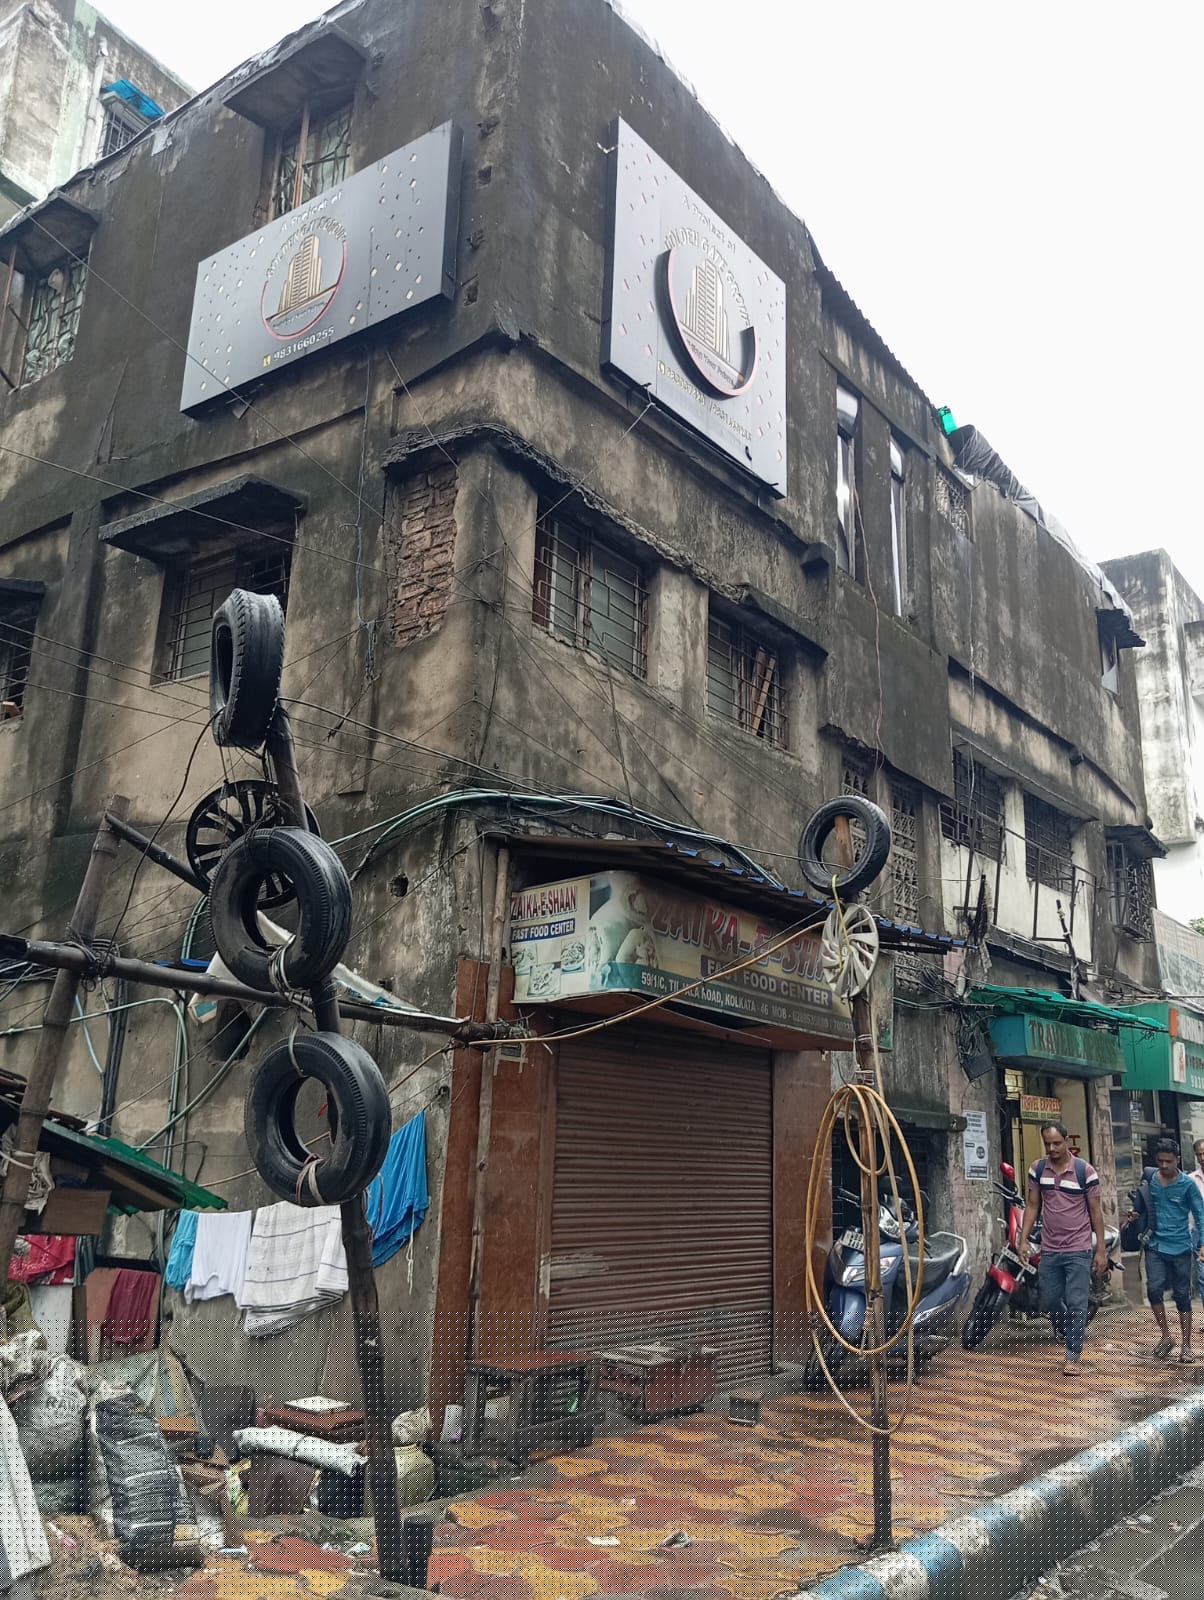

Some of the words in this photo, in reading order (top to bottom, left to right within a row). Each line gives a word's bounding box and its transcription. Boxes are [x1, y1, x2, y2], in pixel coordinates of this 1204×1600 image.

[266, 229, 301, 278] GOLDEN
[700, 236, 727, 273] GATE
[273, 326, 335, 361] 9831660255
[511, 885, 578, 922] ZAIKA-E-SHAAN
[512, 927, 529, 941] FAST
[530, 924, 550, 939] FOOD
[550, 919, 575, 936] CENTER
[701, 987, 724, 1007] ROAD,
[725, 993, 757, 1013] KOLKATA
[743, 971, 777, 993] FOOD
[780, 979, 829, 1006] CENTER
[1021, 1095, 1040, 1111] TRAVEL
